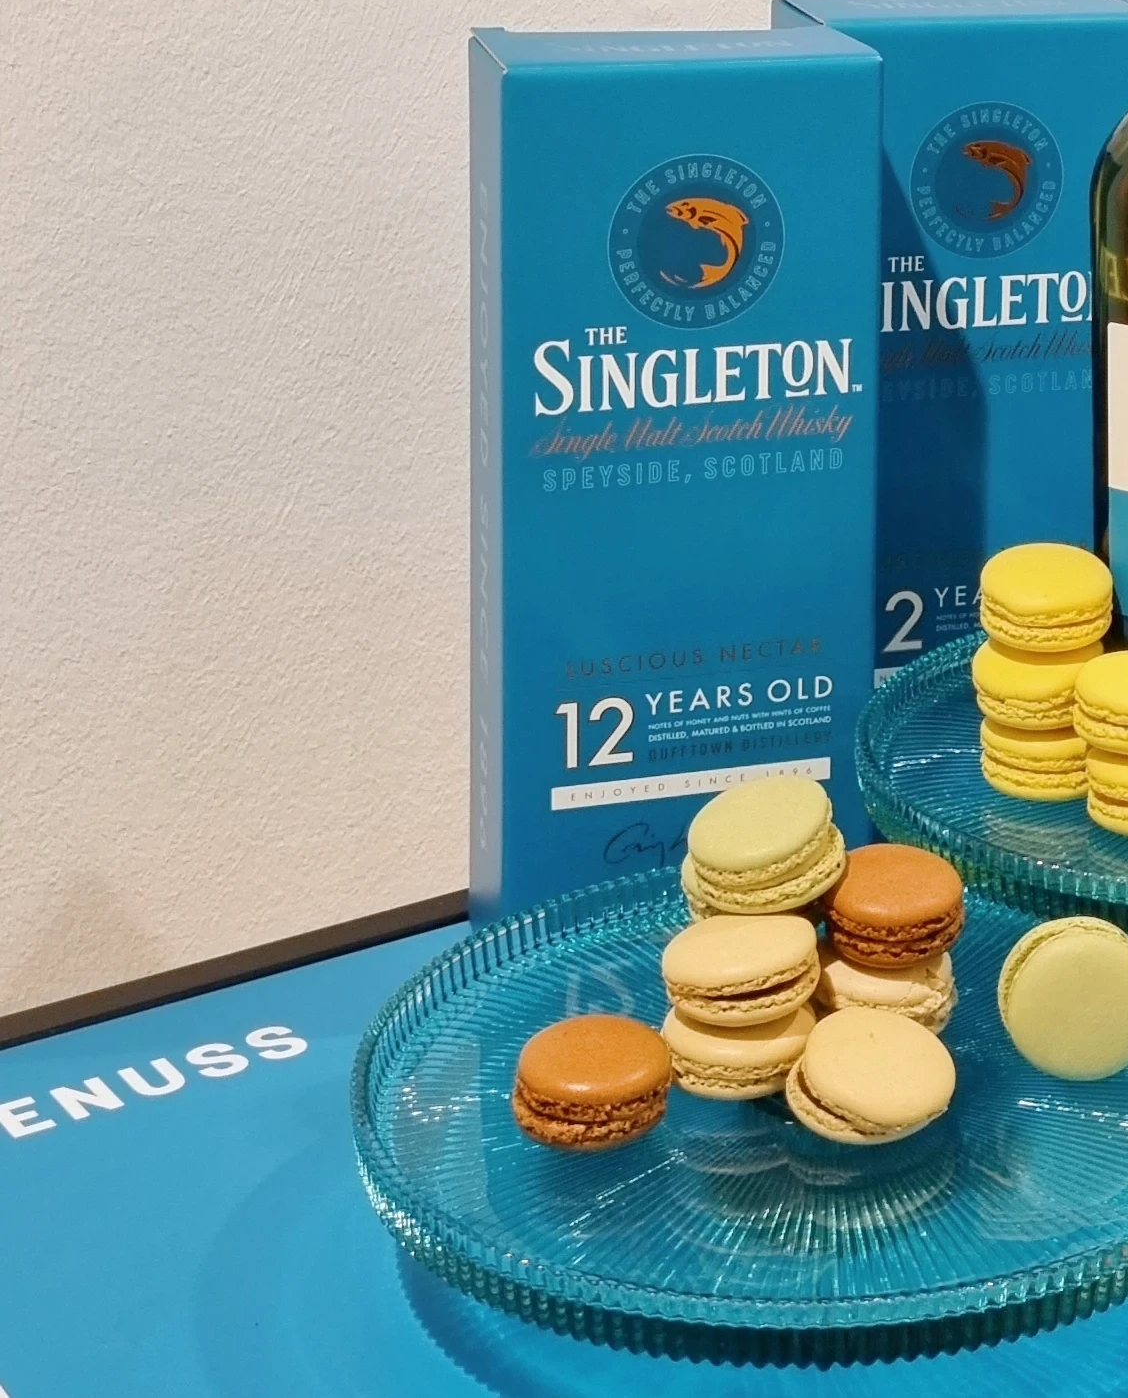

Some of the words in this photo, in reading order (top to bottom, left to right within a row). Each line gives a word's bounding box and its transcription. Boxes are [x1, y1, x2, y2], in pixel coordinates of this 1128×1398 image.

[961, 108, 1048, 151] SINGLETON
[627, 180, 660, 213] THE
[665, 163, 767, 208] SINGLETON
[617, 248, 695, 321] PERFECTLY
[705, 242, 776, 320] BALANCED
[888, 255, 925, 273] THE
[880, 270, 1092, 333] INGLETO
[585, 327, 627, 346] THE
[534, 338, 853, 417] SINGLETON
[989, 368, 1092, 395] SCOTLAN
[765, 402, 854, 443] Whisky
[543, 460, 692, 492] SPEYSIDE,
[704, 448, 844, 480] SCOTLAND
[883, 591, 923, 653] 2
[567, 649, 704, 679] LUSCIOUS
[720, 638, 822, 664] NECTAR
[554, 695, 635, 769] 12
[645, 682, 754, 716] YEARS
[767, 675, 834, 703] OLD
[648, 721, 672, 730] NOTES
[691, 726, 730, 737] MATURED
[732, 725, 738, 733] &
[740, 721, 774, 732] BOTTLED
[776, 720, 785, 728] IN
[787, 715, 832, 727] SCOTLAND
[570, 783, 665, 802] ENJOYED
[685, 773, 746, 789] SINCE
[0, 1026, 308, 1139] ENUSS
